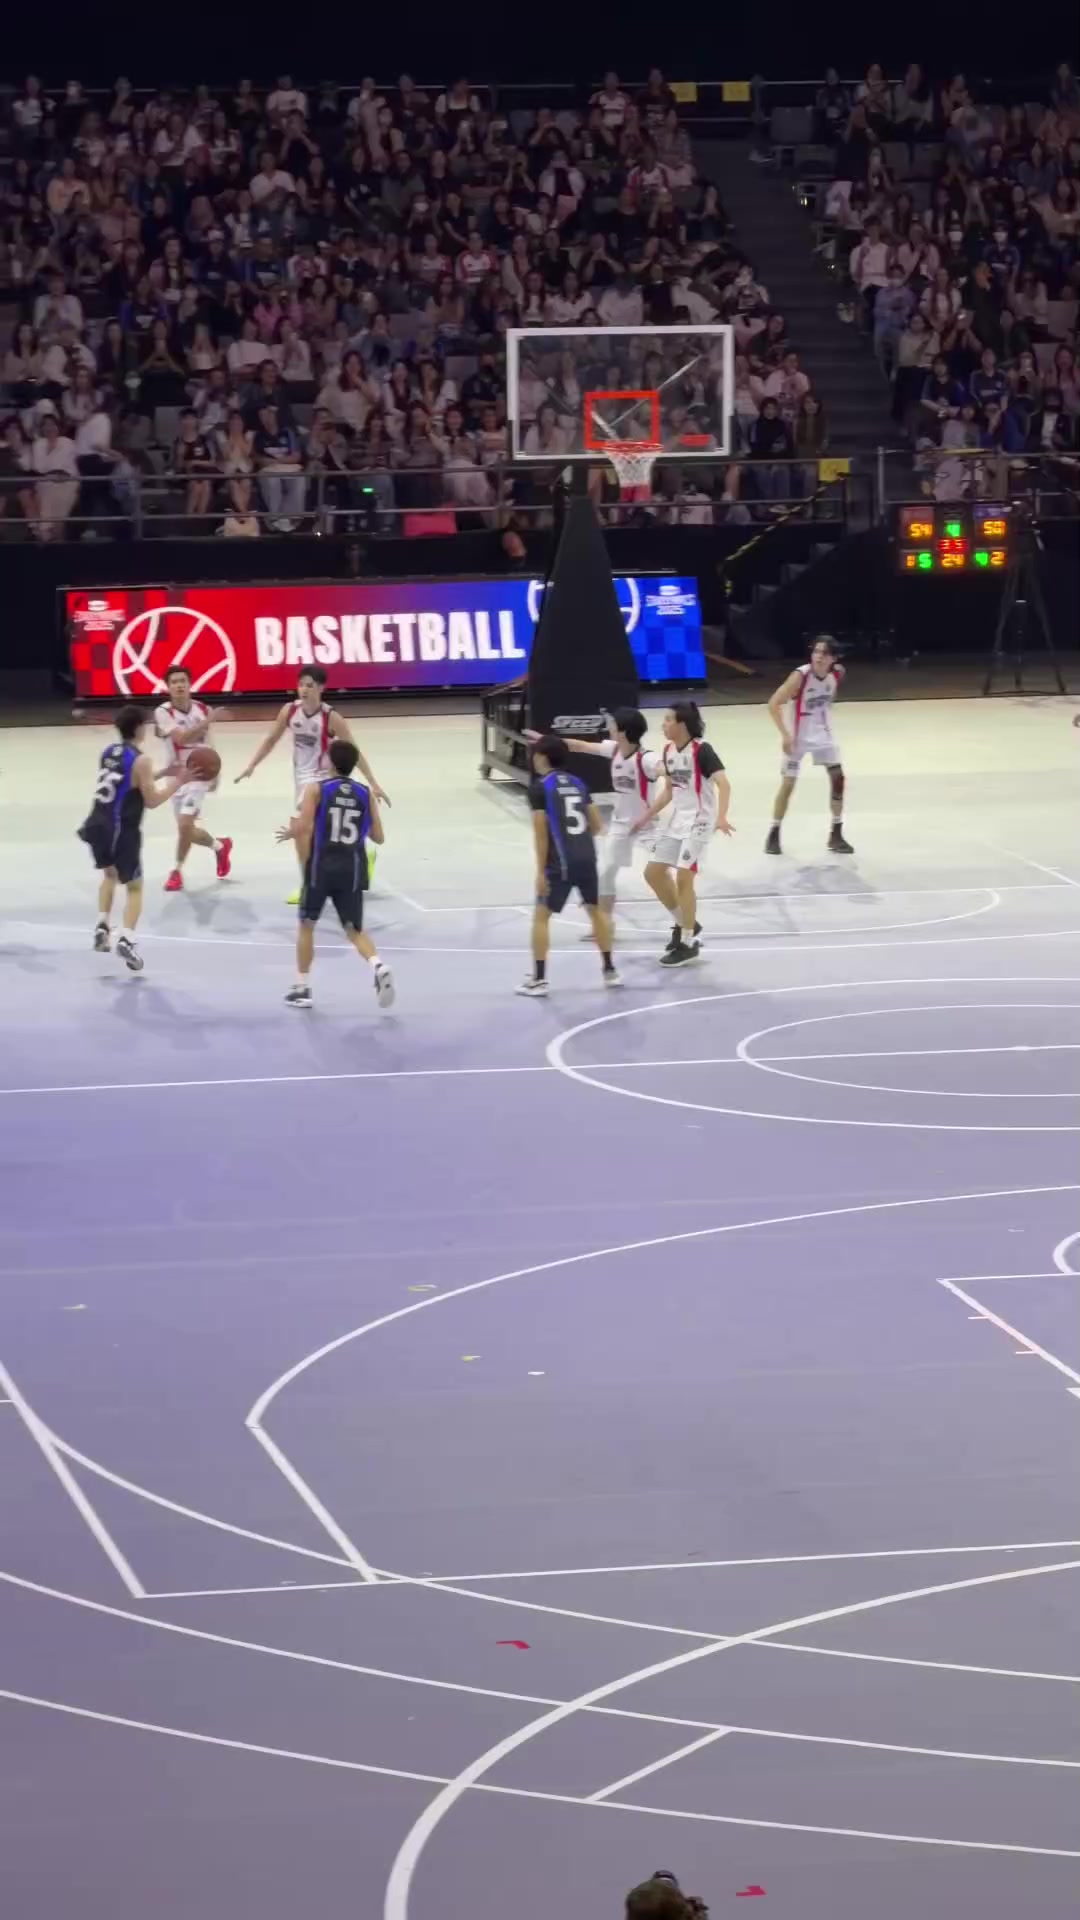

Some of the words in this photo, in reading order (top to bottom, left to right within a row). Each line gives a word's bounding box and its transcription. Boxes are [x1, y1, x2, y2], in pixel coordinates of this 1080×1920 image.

[910, 523, 933, 538] 54
[254, 610, 526, 666] BASKETBALL
[328, 806, 362, 844] 15
[565, 796, 585, 835] 5
